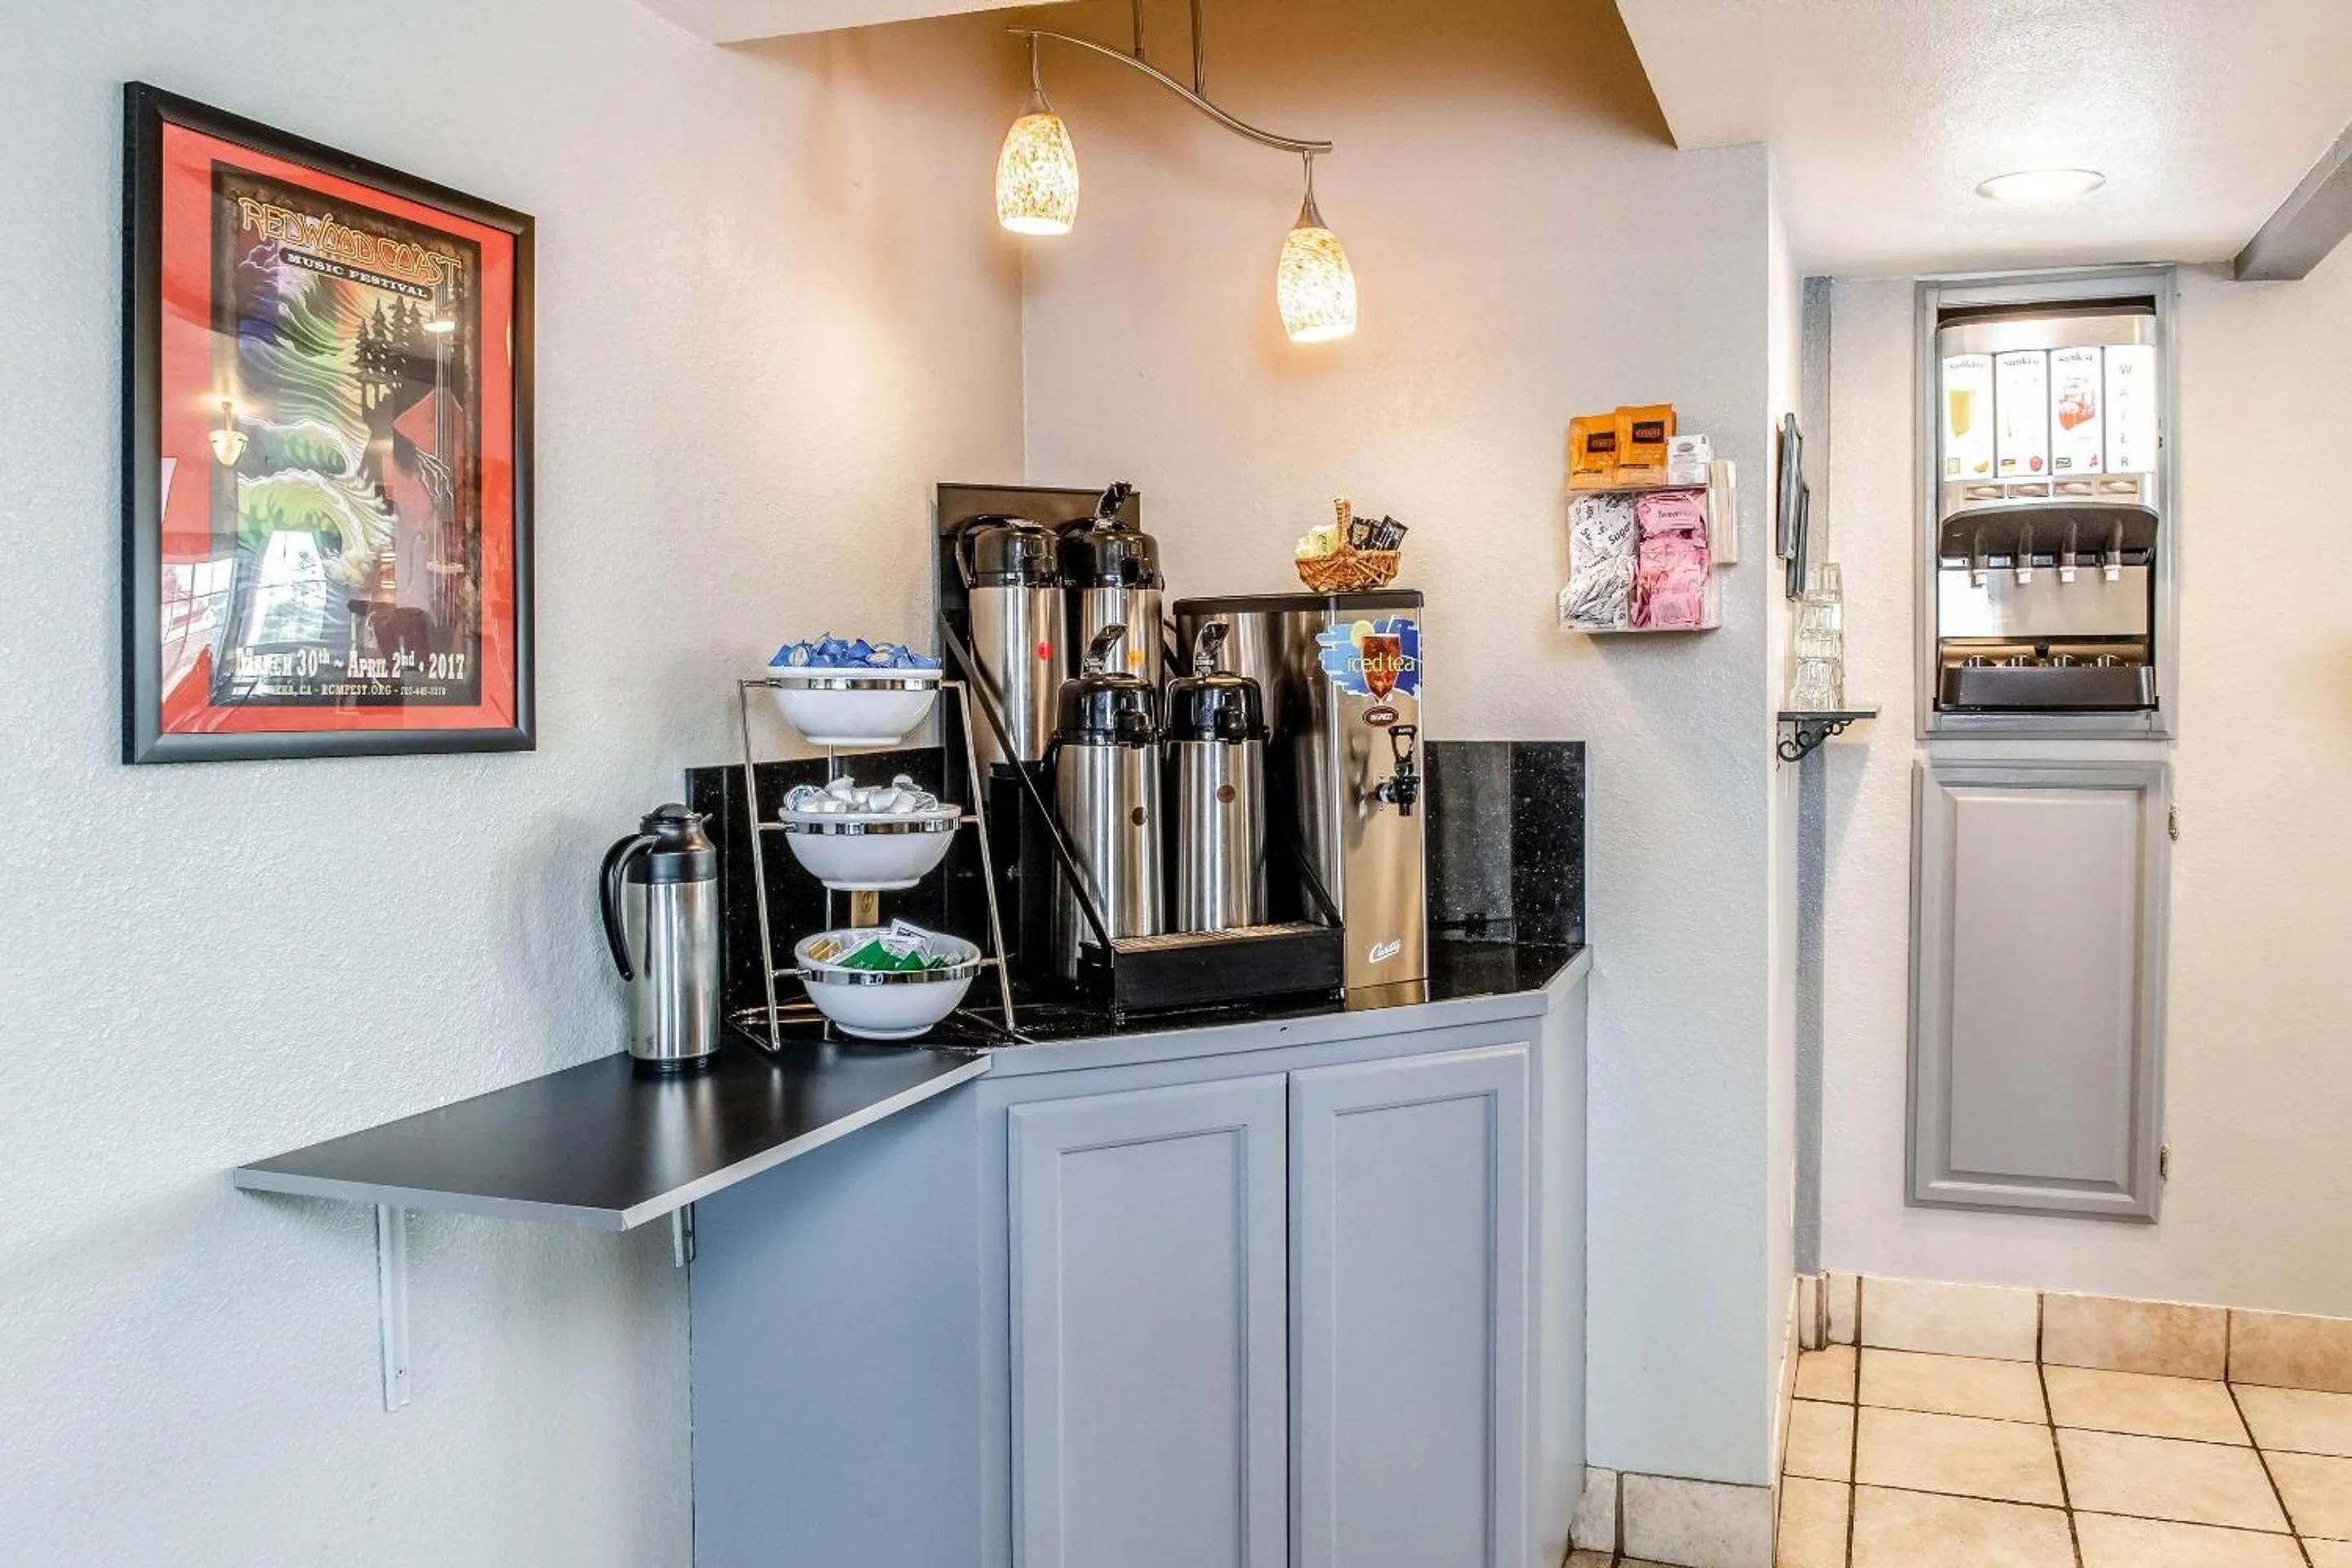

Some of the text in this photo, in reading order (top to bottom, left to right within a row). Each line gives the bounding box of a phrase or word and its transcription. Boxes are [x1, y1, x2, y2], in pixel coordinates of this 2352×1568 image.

[238, 197, 461, 287] REDWOOD COAST
[287, 252, 427, 298] MUSIC FESTIVAL
[428, 653, 465, 679] 2017
[1347, 652, 1414, 672] iced tea
